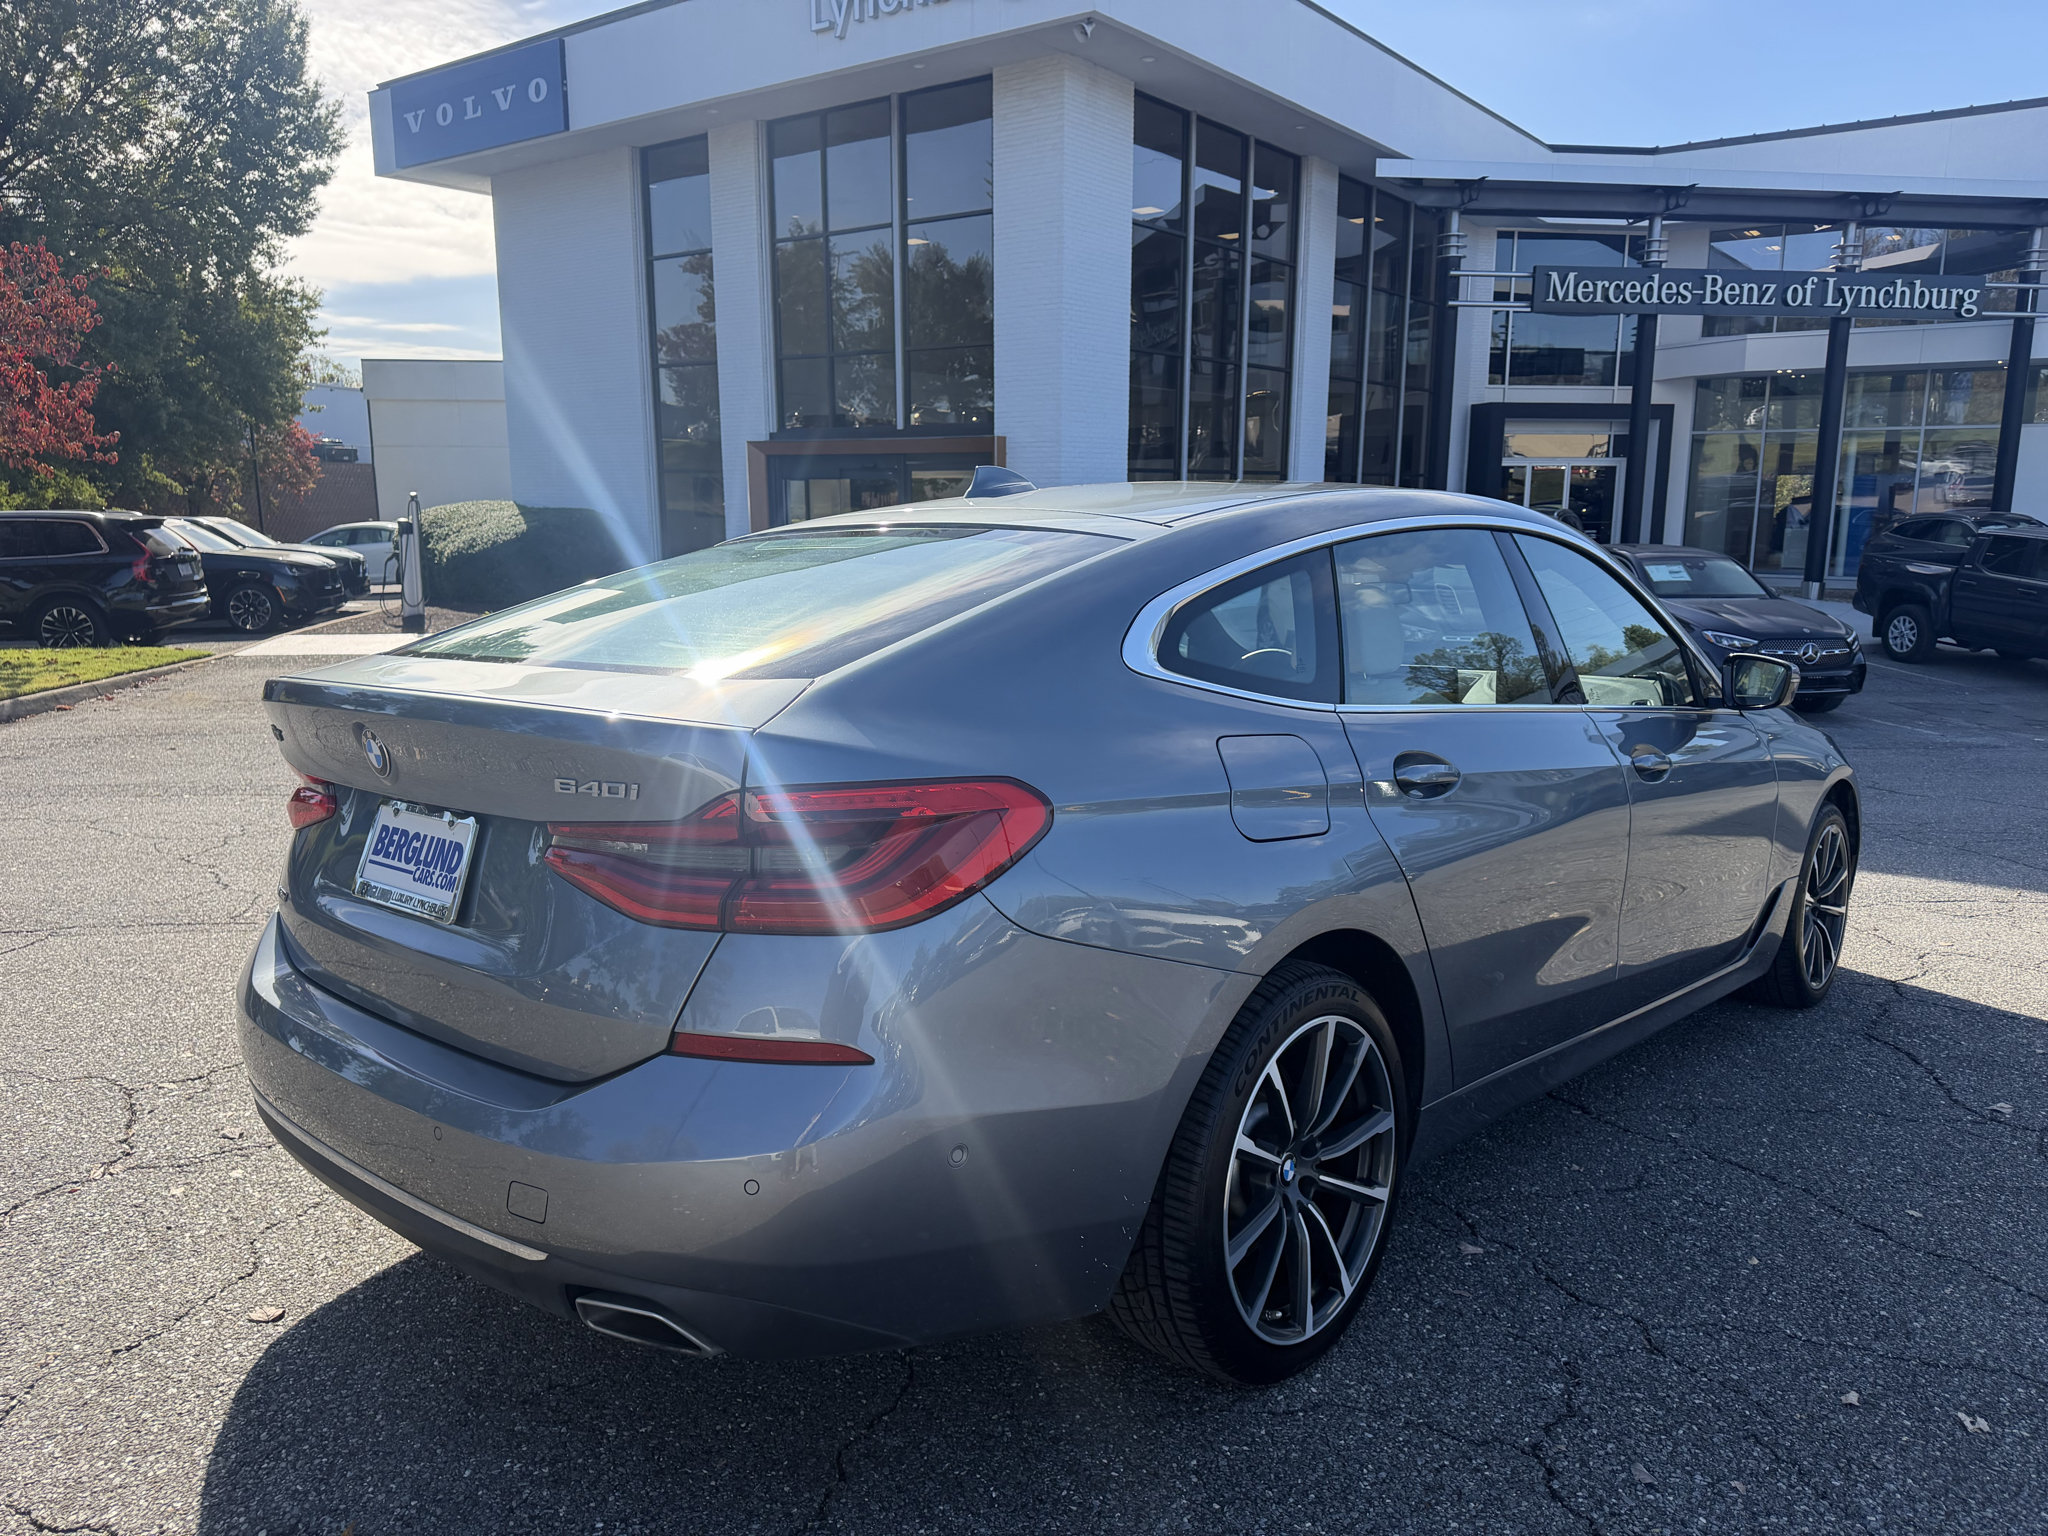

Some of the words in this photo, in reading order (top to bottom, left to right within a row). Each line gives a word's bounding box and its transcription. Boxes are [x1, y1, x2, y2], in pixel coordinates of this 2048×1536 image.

[810, 0, 950, 39] Lyn
[403, 77, 548, 134] VOLVO
[1546, 271, 1777, 306] Mercedes-Benz
[1787, 276, 1818, 307] of
[1823, 277, 1980, 318] Lynchburg
[554, 778, 639, 801] 640i
[372, 824, 464, 875] BERGLUND
[412, 867, 457, 893] CARS.COM
[1234, 985, 1360, 1098] CONTINENTAL
